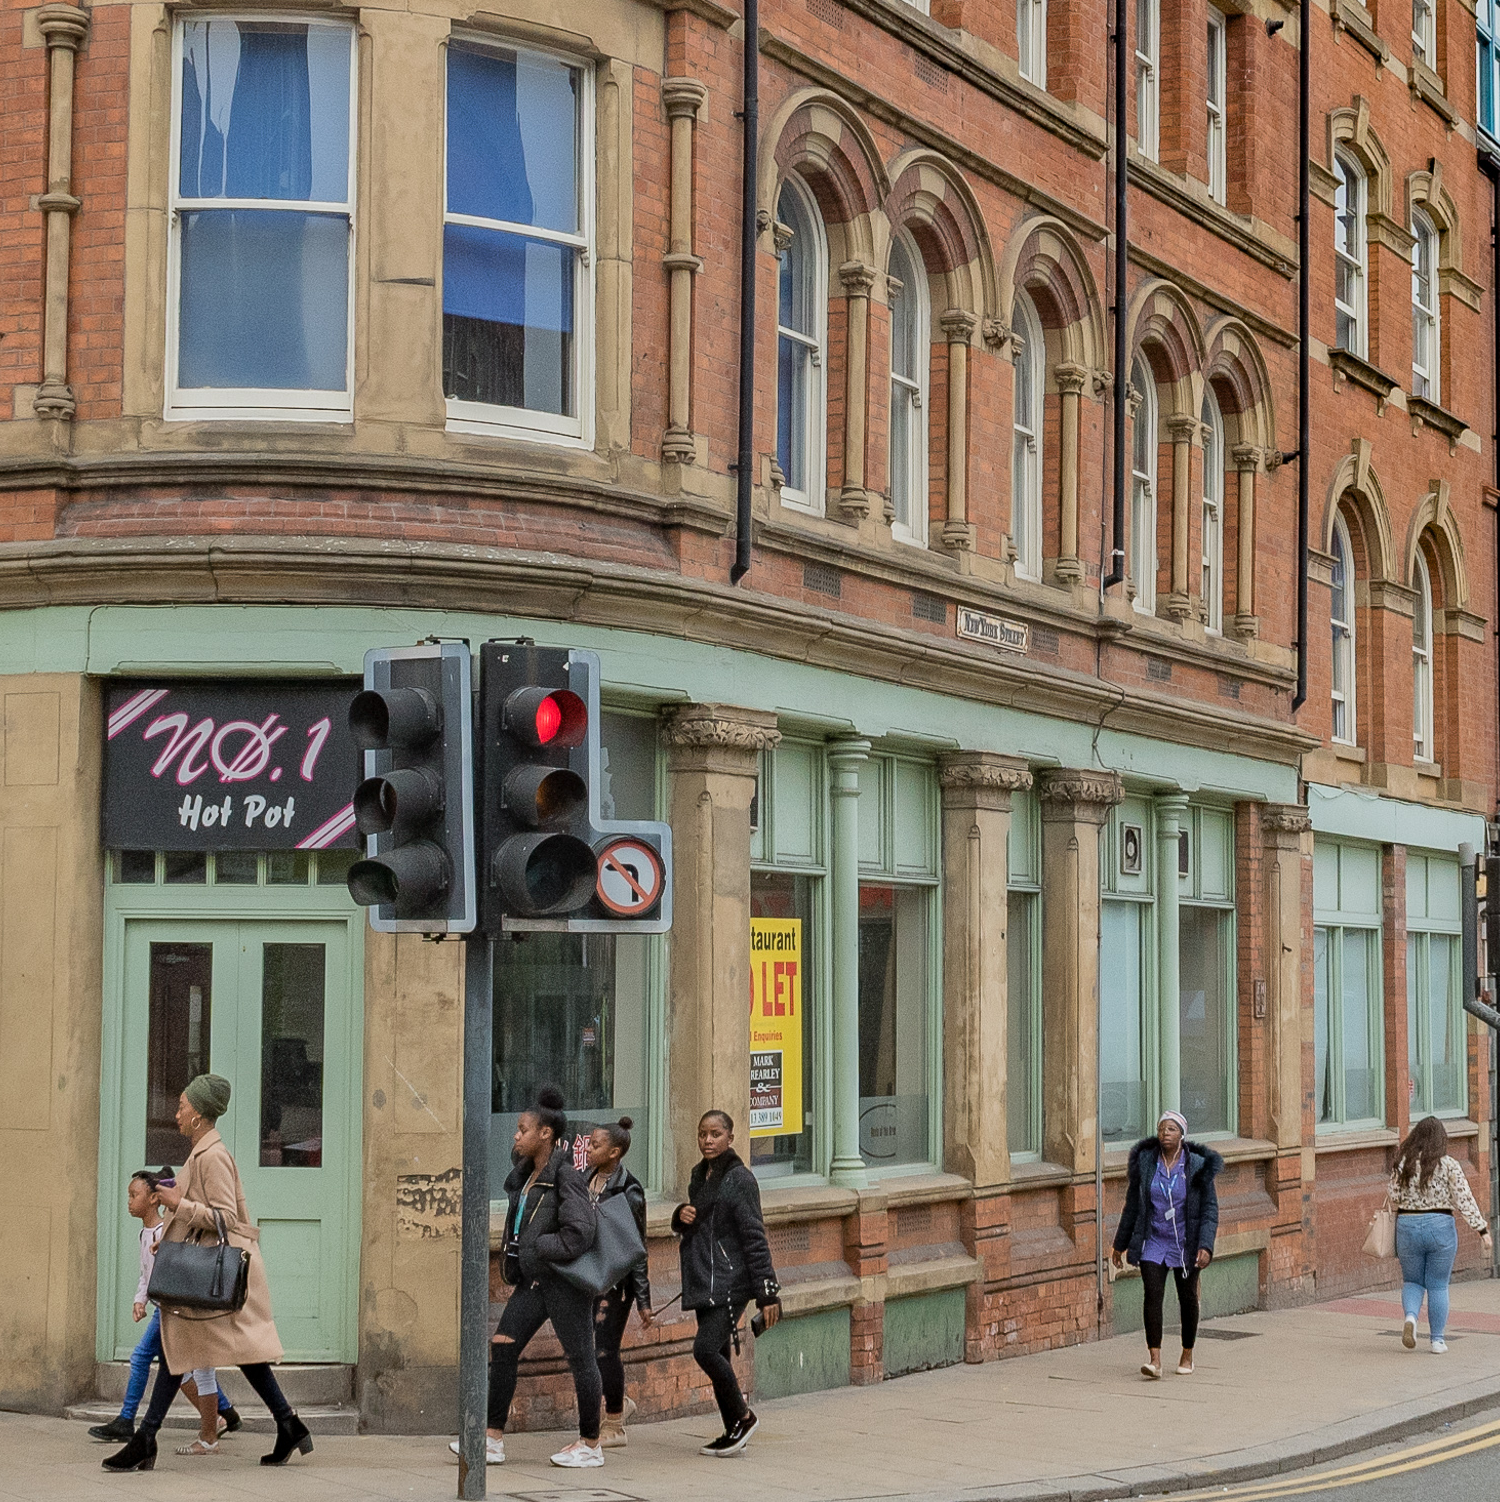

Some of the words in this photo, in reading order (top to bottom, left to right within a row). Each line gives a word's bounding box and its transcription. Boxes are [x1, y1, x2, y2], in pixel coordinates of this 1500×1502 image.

[178, 794, 233, 832] Hot
[243, 794, 295, 829] Pot
[761, 961, 798, 1017] LET
[753, 1030, 783, 1043] Enquiries
[753, 1055, 774, 1067] MARK
[755, 1082, 771, 1093] &
